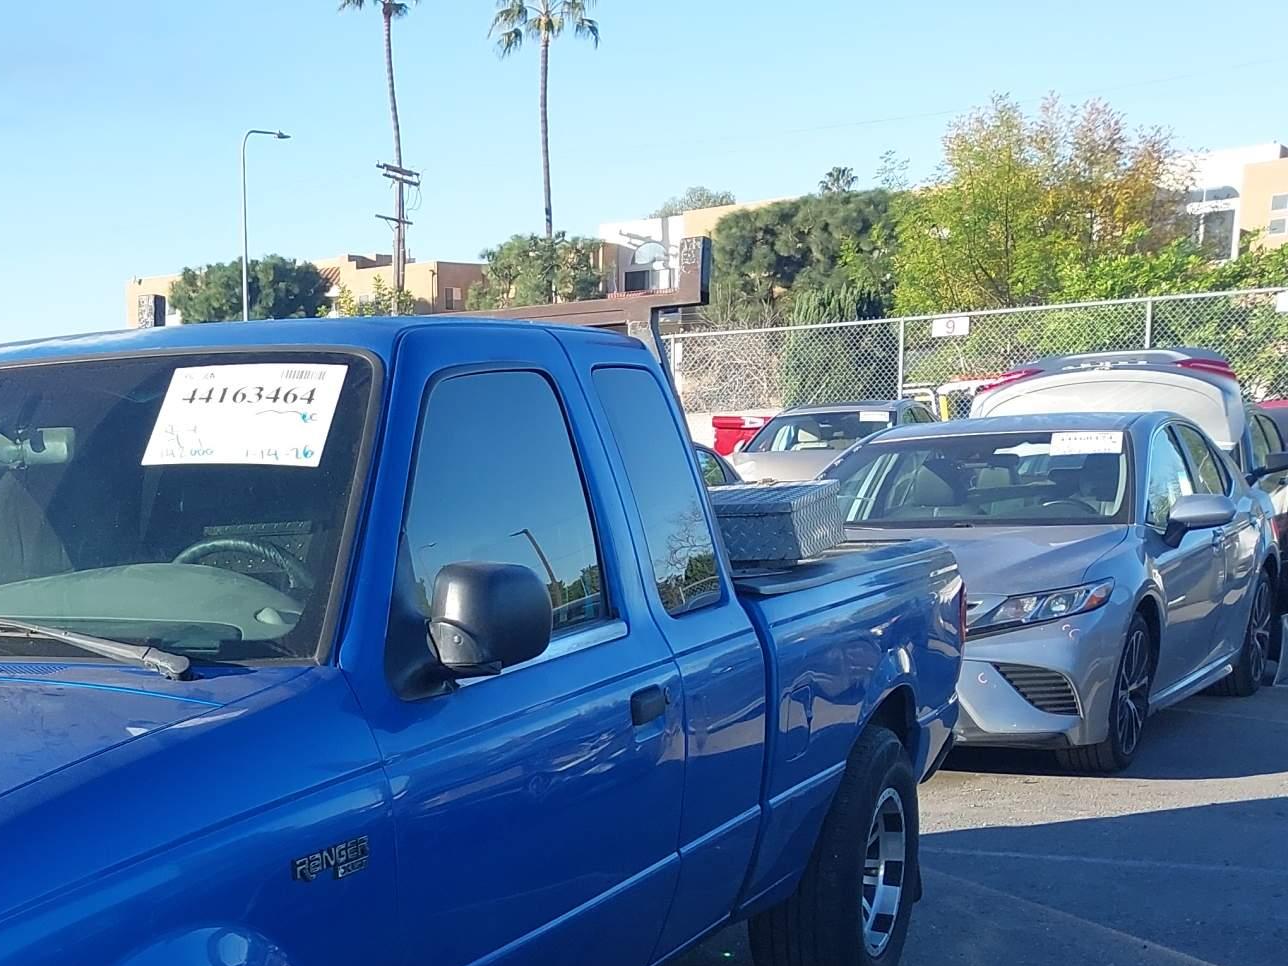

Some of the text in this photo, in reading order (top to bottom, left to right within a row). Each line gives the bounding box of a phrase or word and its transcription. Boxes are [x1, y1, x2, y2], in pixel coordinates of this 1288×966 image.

[946, 319, 955, 335] 9
[182, 386, 317, 405] 44163464
[295, 835, 369, 880] RANGER
